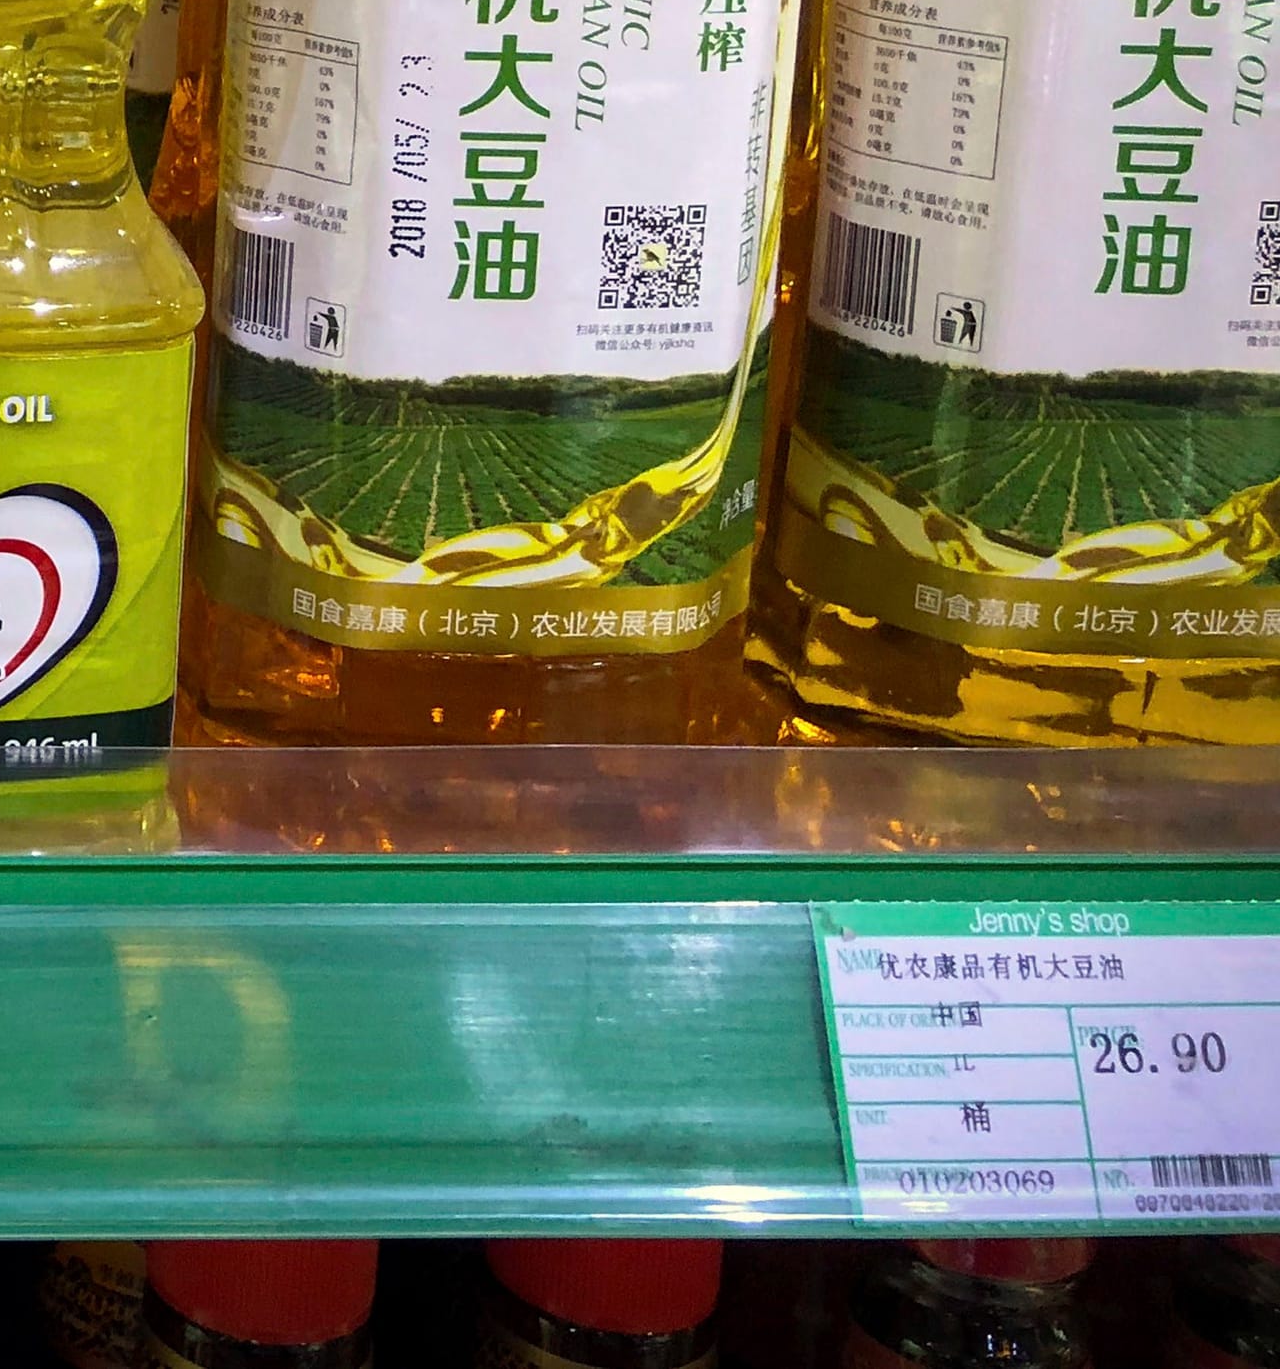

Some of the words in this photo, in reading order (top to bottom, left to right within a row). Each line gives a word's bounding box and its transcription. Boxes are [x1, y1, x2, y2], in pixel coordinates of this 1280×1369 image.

[575, 59, 610, 130] OIL
[1232, 55, 1269, 127] OIL
[969, 908, 1063, 935] Jenny's
[1070, 909, 1129, 935] shop
[879, 952, 1125, 982] 优农康品有机大豆油
[842, 1012, 886, 1028] PLACE
[889, 1012, 910, 1028] OF
[931, 1001, 983, 1028] 中国
[1090, 1032, 1227, 1074] 26.90
[960, 1102, 991, 1132] 桶
[899, 1169, 1054, 1194] 010203069
